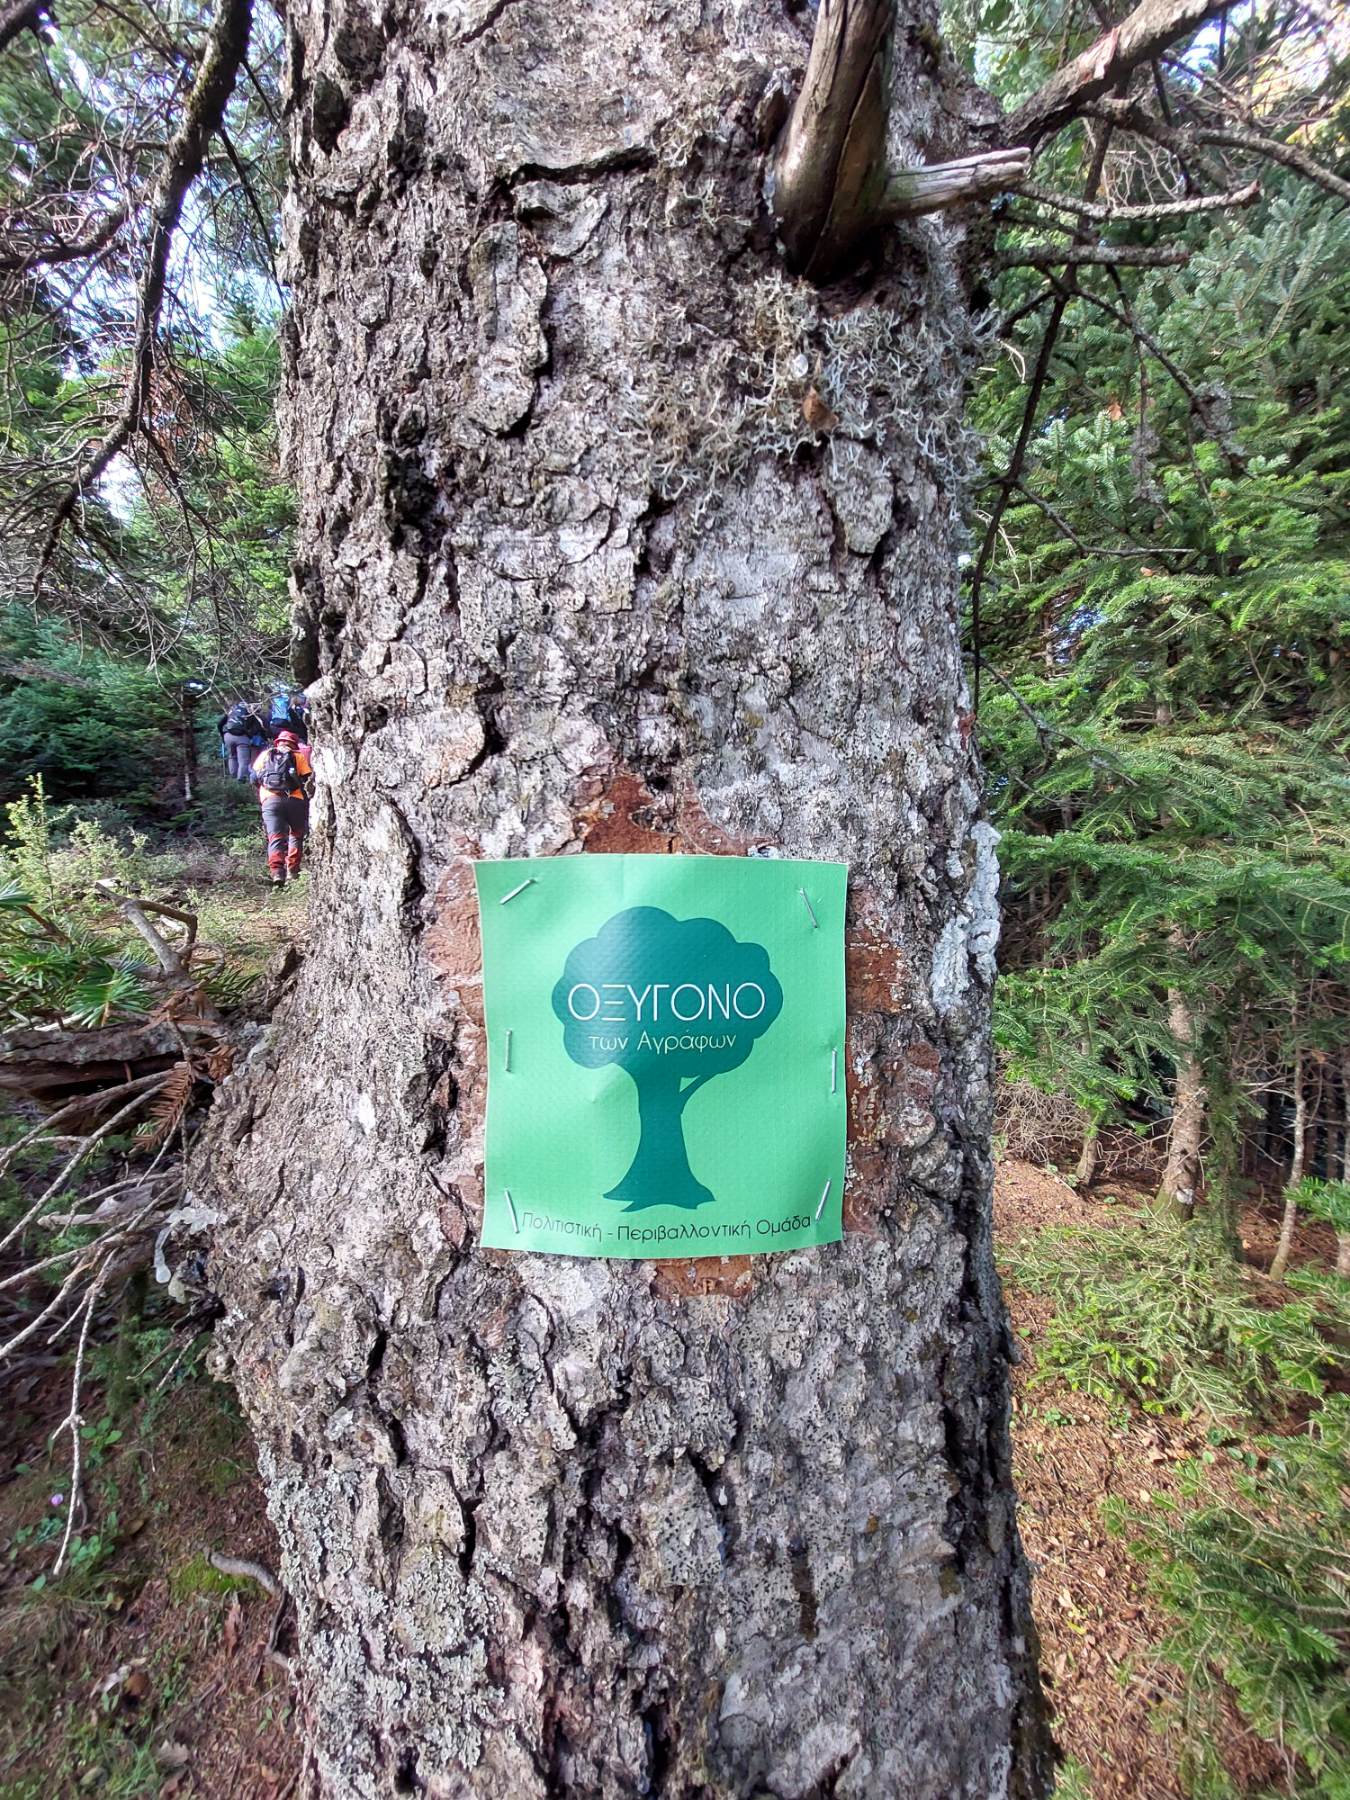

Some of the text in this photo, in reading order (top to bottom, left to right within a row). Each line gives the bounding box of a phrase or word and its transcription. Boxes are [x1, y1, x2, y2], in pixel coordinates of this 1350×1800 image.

[567, 982, 766, 1022] ΟΞΥΓΟΝΟ
[588, 1029, 737, 1055] των Αγράφων
[521, 1212, 602, 1243] Πολιτιστική
[617, 1219, 751, 1243] Περιβαλλοντική
[755, 1214, 811, 1236] Ομάδα
